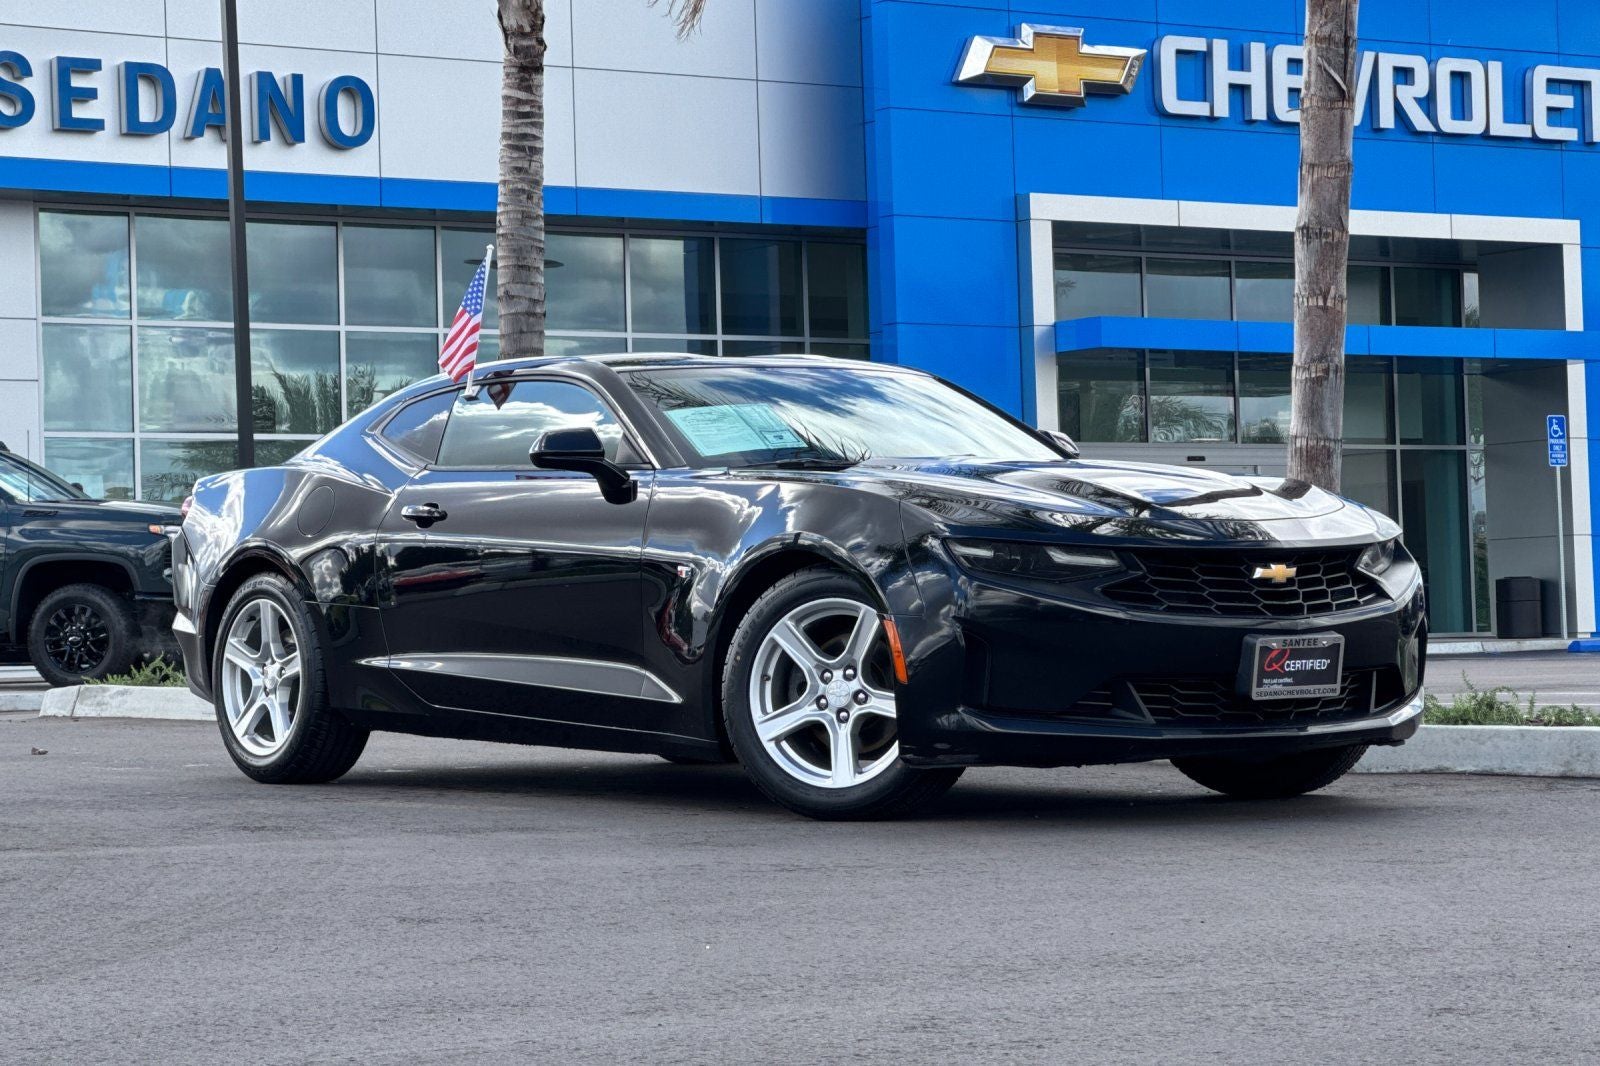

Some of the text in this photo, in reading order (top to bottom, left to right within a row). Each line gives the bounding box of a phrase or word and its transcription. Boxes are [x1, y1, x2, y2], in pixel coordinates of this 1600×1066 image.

[0, 50, 376, 150] SEDANO
[1281, 638, 1319, 648] SANTEE
[1255, 688, 1338, 698] SEDANOCHEVROLET.COM
